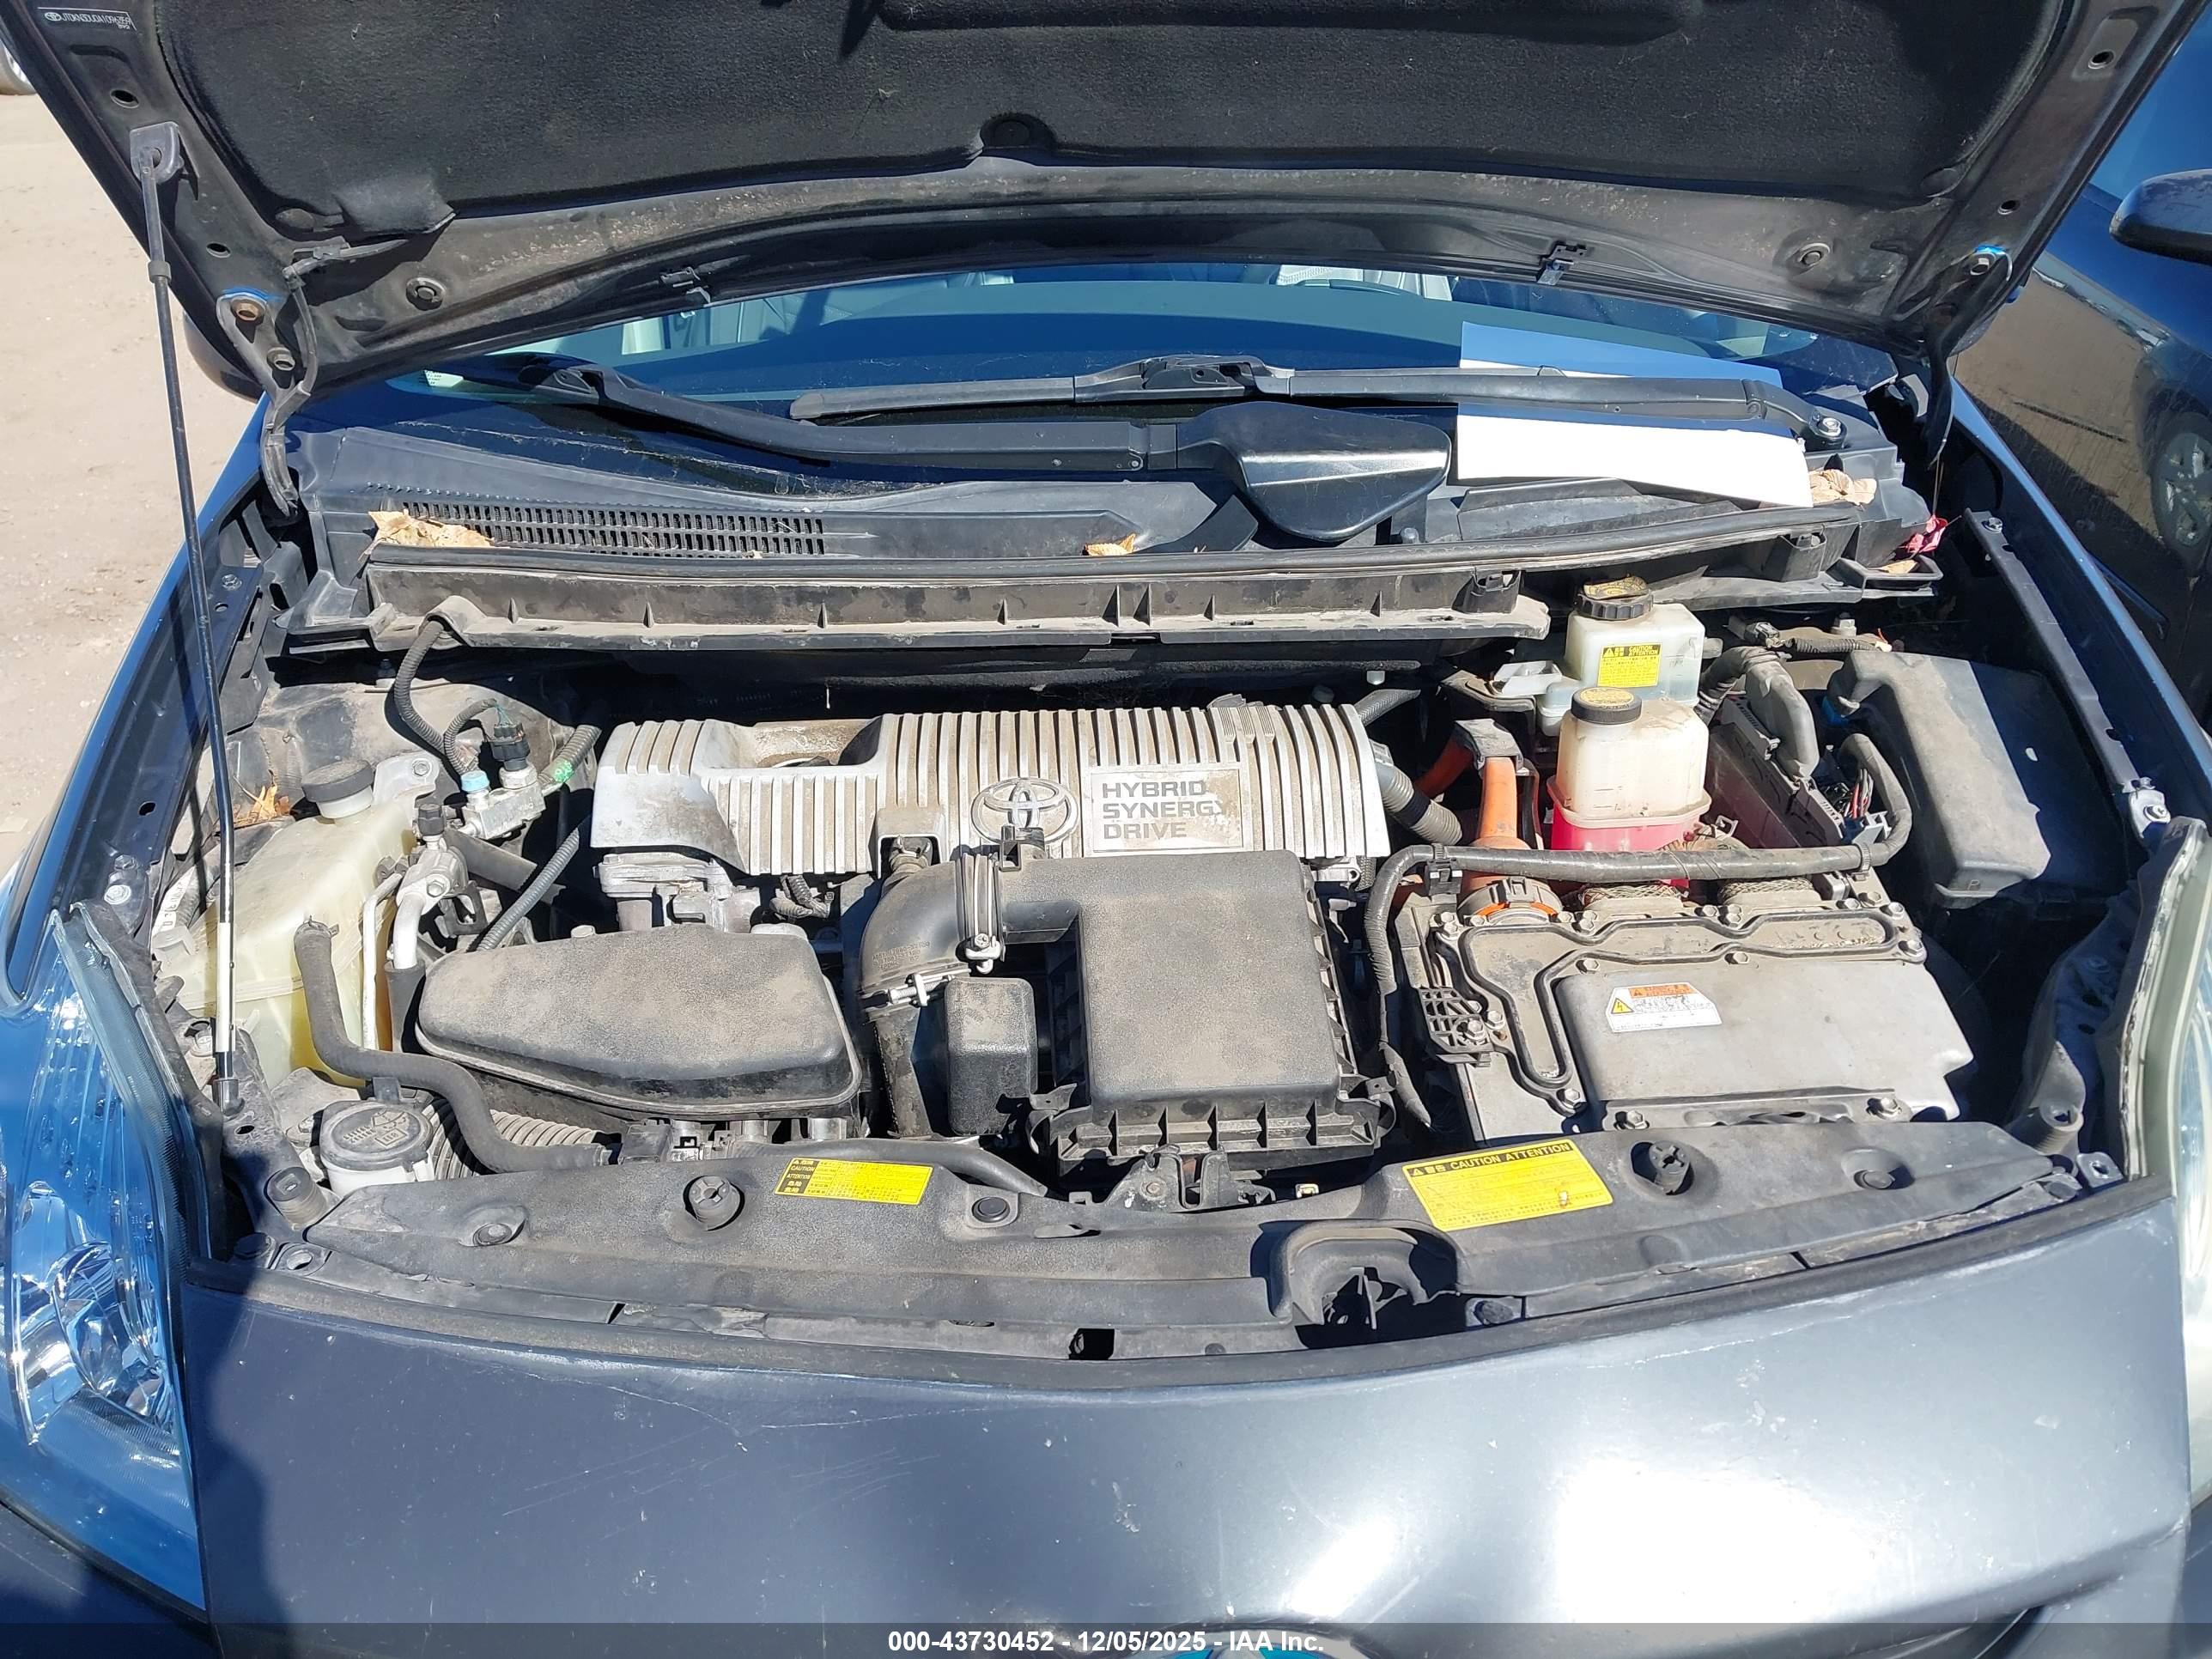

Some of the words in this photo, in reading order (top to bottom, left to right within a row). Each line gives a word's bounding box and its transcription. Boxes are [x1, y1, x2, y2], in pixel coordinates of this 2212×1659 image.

[1102, 780, 1206, 799] HYBRID
[1103, 800, 1226, 819] SYNERGY
[1103, 822, 1188, 839] DRIVE
[1449, 1155, 1502, 1170] CAUTION
[1505, 1143, 1571, 1161] ATTENTION
